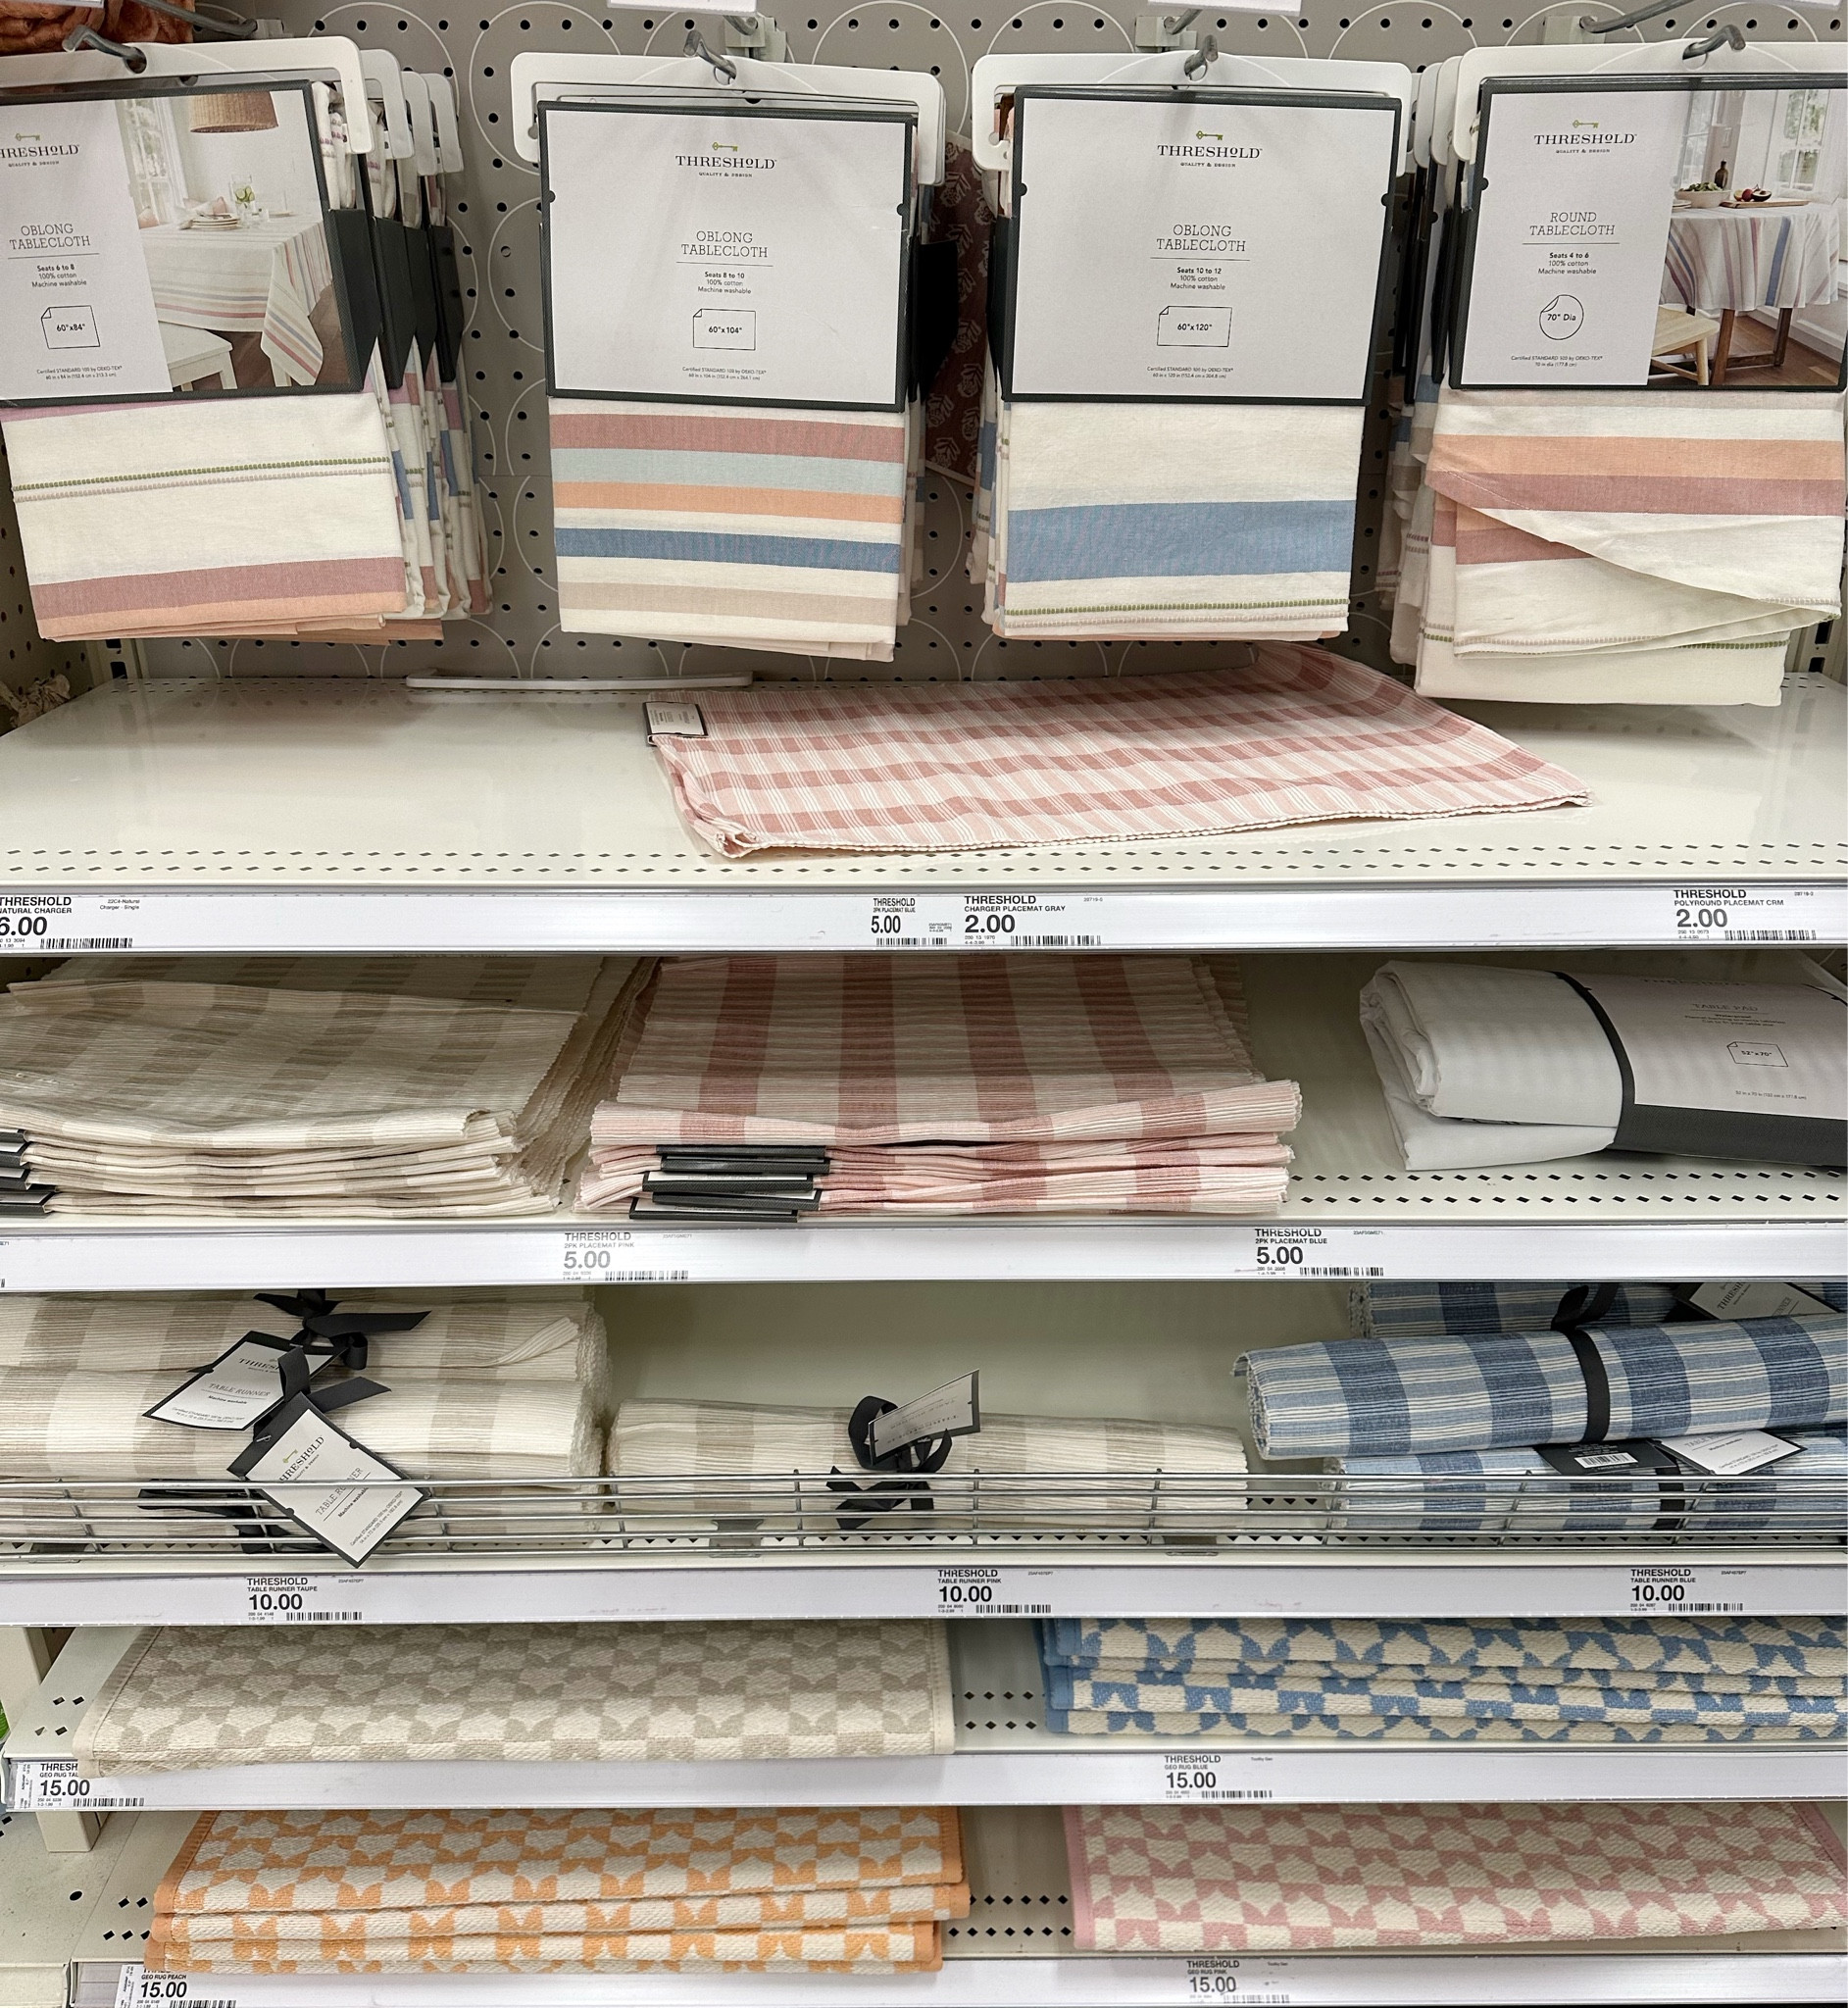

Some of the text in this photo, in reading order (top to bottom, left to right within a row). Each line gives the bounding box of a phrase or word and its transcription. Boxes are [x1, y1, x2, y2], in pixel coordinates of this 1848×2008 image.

[1533, 133, 1635, 145] THRESHOLD
[0, 144, 78, 158] RESHOLD
[1157, 144, 1261, 159] THRESHOLD
[675, 155, 775, 170] THRESHOLD
[1550, 212, 1597, 223] ROUND
[21, 224, 74, 236] OBLONG
[696, 230, 753, 243] OBLONG
[1173, 224, 1231, 237] OBLONG
[1529, 225, 1616, 235] TABLECLOTH
[9, 235, 91, 250] TABLECLOTH
[1156, 238, 1246, 251] TABLECLOTH
[681, 244, 768, 258] TABLECLOTH
[964, 895, 1036, 905] THRESHOLD
[1673, 889, 1746, 899] THRESHOLD
[873, 897, 916, 907] THRESHOLD
[871, 915, 901, 933] 5.00
[965, 914, 1016, 933] 2.00
[1675, 908, 1728, 928] 2.00
[0, 916, 48, 936] 6.00
[564, 1231, 631, 1241] THRESHOLD
[1255, 1228, 1322, 1237] THRESHOLD
[564, 1250, 611, 1269] 5.00
[1256, 1246, 1304, 1265] 5.00
[239, 1358, 279, 1371] THRES
[209, 1382, 235, 1392] TABLE
[278, 1436, 325, 1481] HRESHOLD
[315, 1493, 338, 1515] TABLE
[337, 1502, 353, 1518] Machine
[937, 1569, 998, 1578] THRESHOLD
[938, 1585, 992, 1602] 10.00
[1631, 1584, 1685, 1601] 10.00
[248, 1593, 303, 1611] 10.00
[1164, 1755, 1222, 1764] THRESHOLD
[1166, 1772, 1217, 1788] 15.00
[40, 1780, 90, 1796] 15.00
[1186, 1960, 1240, 1969] THRESHOLD
[140, 1981, 187, 1998] 15.00
[1189, 1976, 1237, 1993] 15.00
